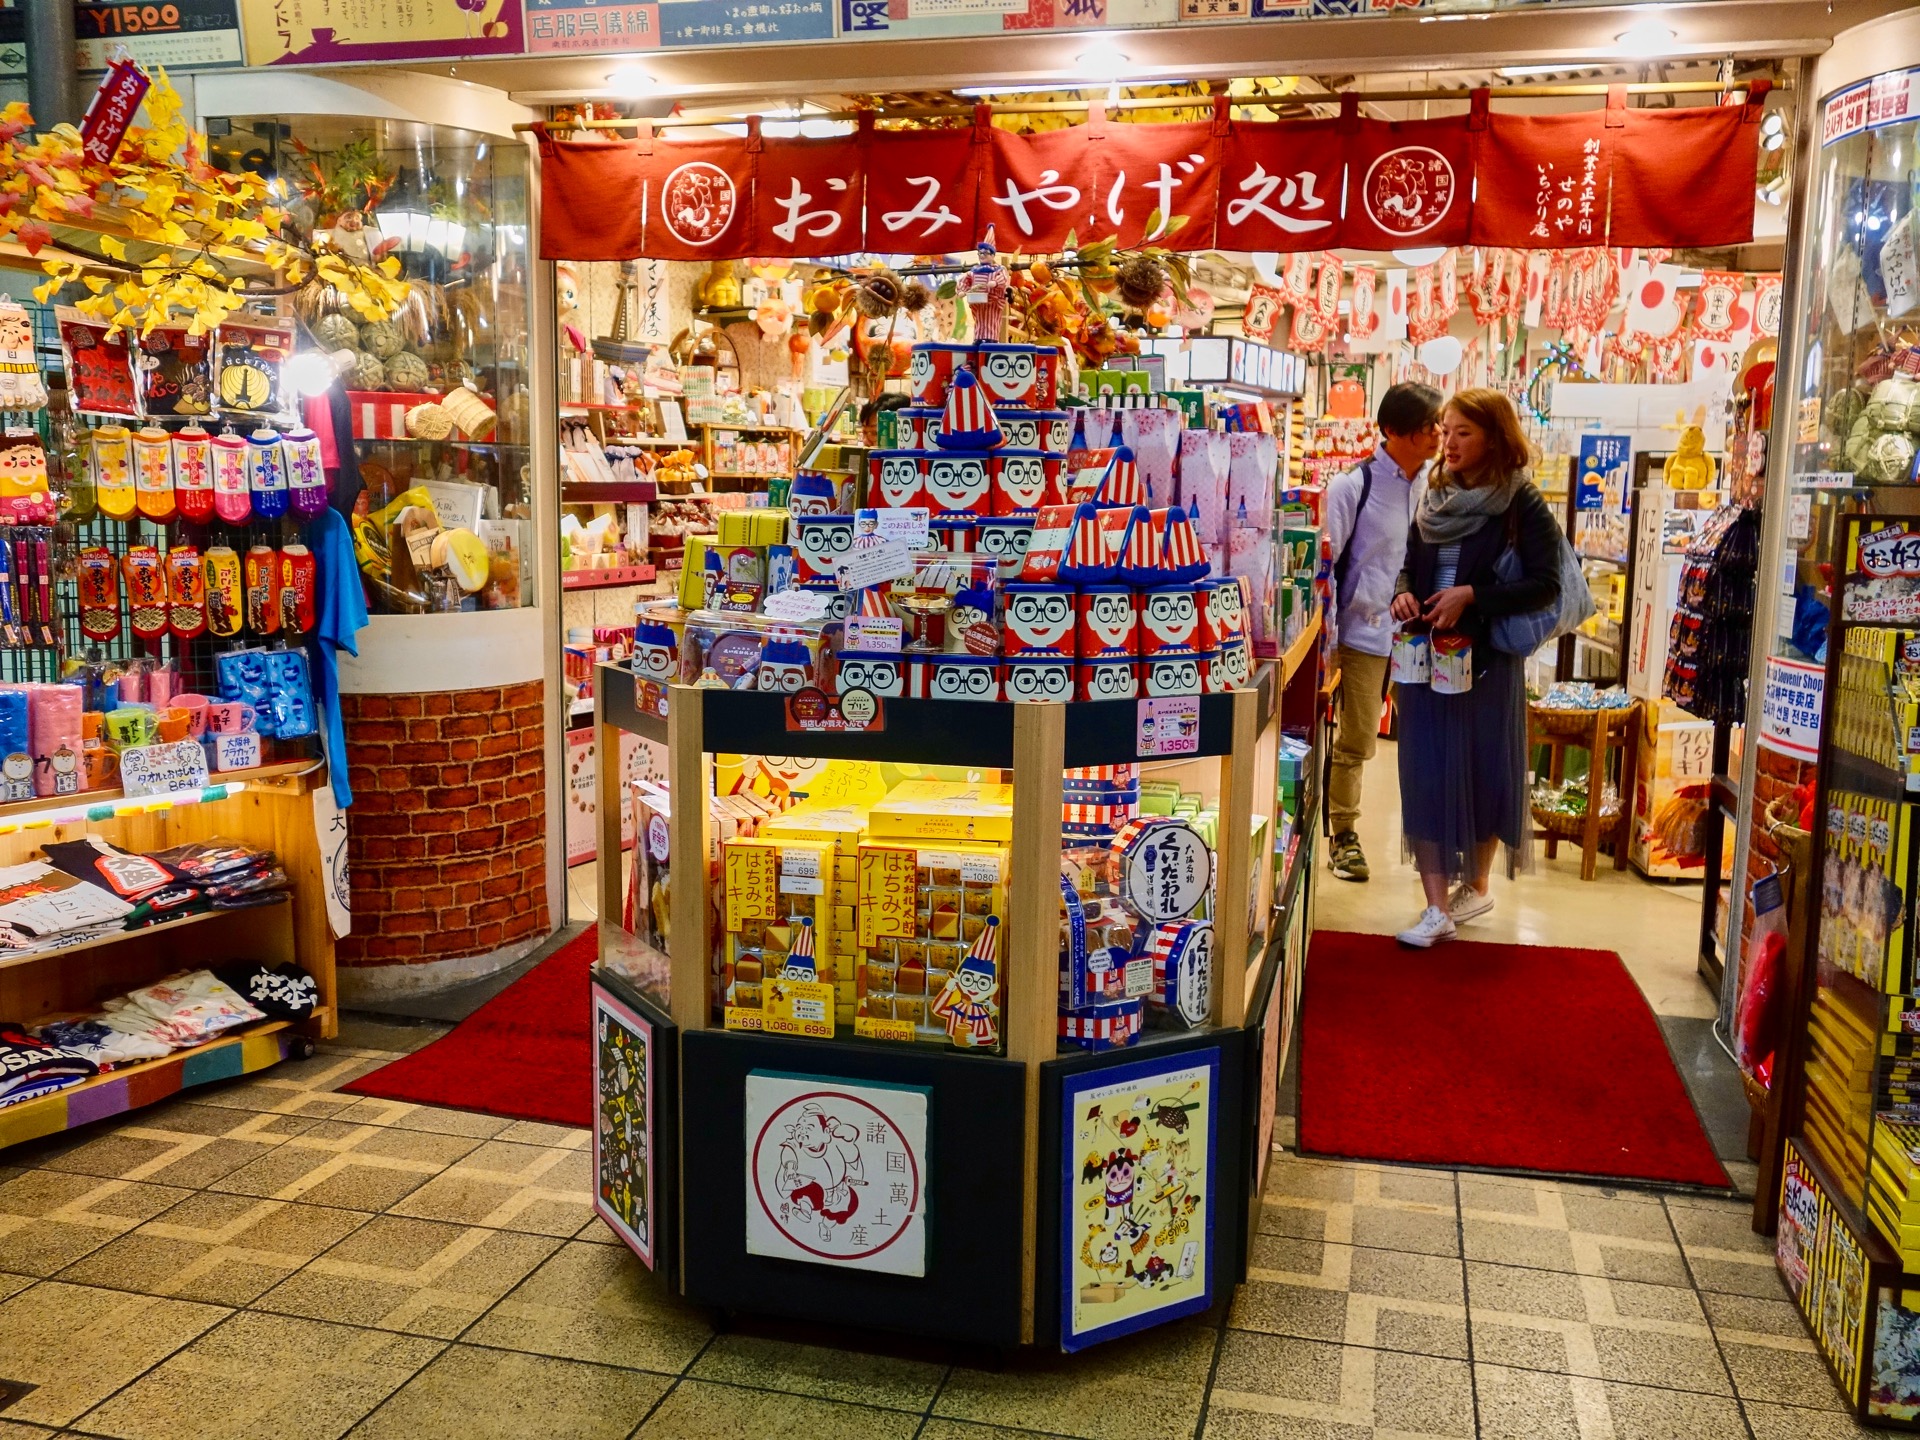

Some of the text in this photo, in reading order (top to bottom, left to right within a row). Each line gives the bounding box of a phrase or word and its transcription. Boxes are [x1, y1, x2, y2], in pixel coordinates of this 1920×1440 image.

[84, 74, 139, 163] おみやげ処
[772, 153, 1333, 243] おみやげ処
[1529, 162, 1555, 238] いちびり庵
[1555, 175, 1577, 232] せのや
[1578, 138, 1600, 235] 創業天正年間
[1777, 669, 1803, 688] Souvenir
[1803, 673, 1823, 693] Shop
[130, 717, 140, 744] オトン
[800, 719, 864, 728] 当店しか買えへんで
[829, 708, 838, 718] &
[1792, 709, 1820, 730] 전문점
[227, 737, 251, 748] 大阪弁
[229, 756, 250, 767] ¥432
[1160, 739, 1195, 752] 1,350円
[1676, 729, 1693, 775] ケーキ
[1694, 729, 1711, 775] バター
[727, 851, 744, 902] ケーキ
[745, 851, 763, 918] はちみつ
[860, 851, 880, 912] ケーキ
[881, 852, 902, 932] はちみつ
[849, 1121, 910, 1248] 諸国萬土産
